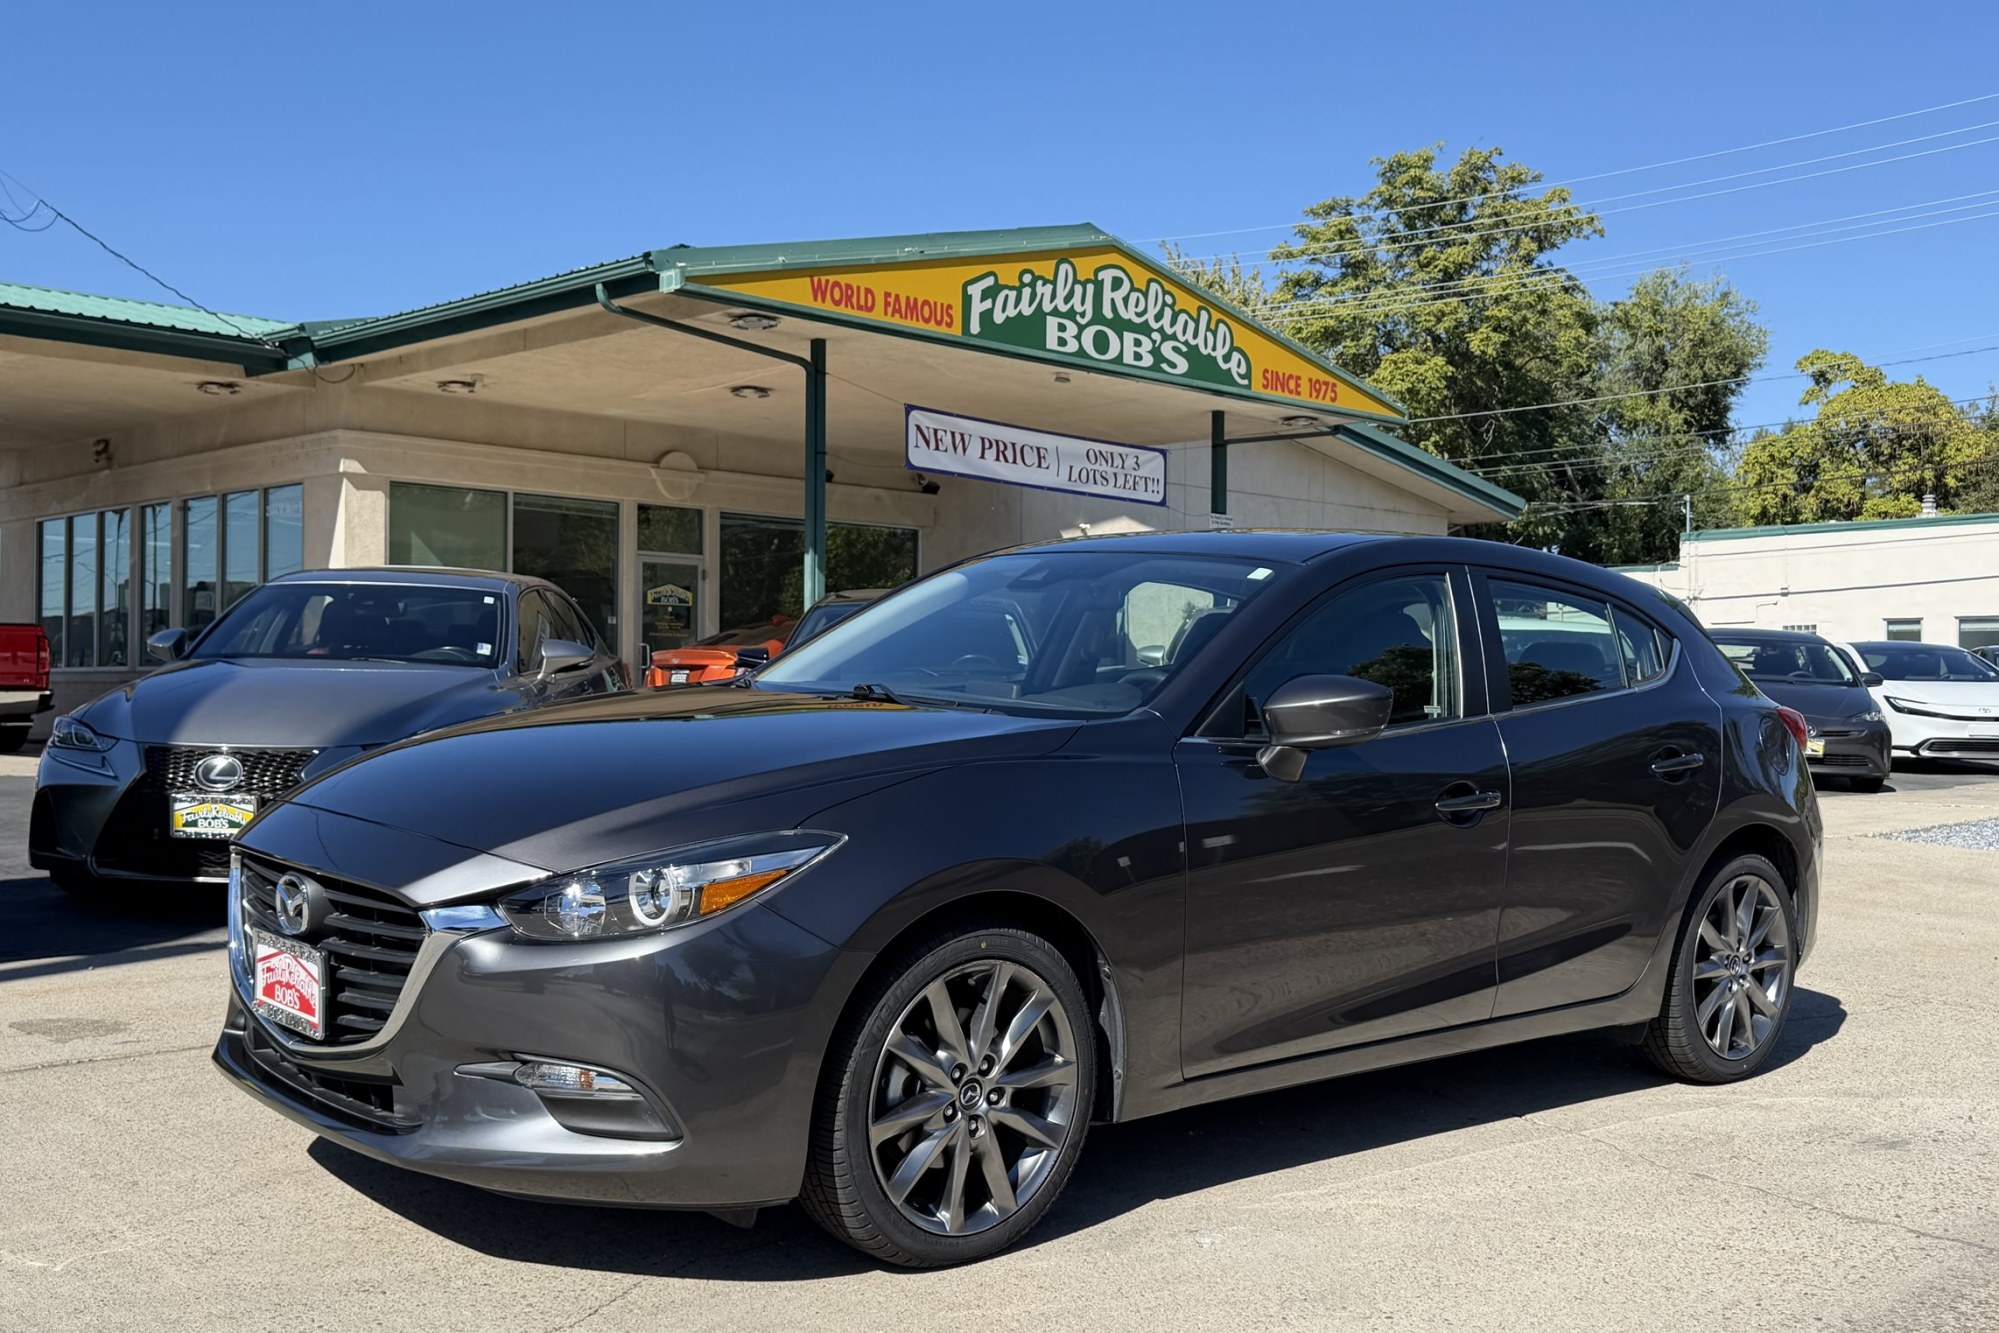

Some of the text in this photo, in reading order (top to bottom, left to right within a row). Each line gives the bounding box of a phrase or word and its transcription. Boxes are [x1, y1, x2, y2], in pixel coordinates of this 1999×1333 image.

[809, 275, 954, 328] WORLD FAMOUS
[967, 262, 1249, 385] Fairly Reliable
[1046, 315, 1189, 375] BOB'S
[1262, 368, 1337, 403] SINCE 1975
[913, 424, 1050, 470] NEW PRICE
[1086, 448, 1141, 471] ONLY 3
[1067, 465, 1160, 494] LOTS LEFT!!
[274, 984, 301, 1009] BOB'S
